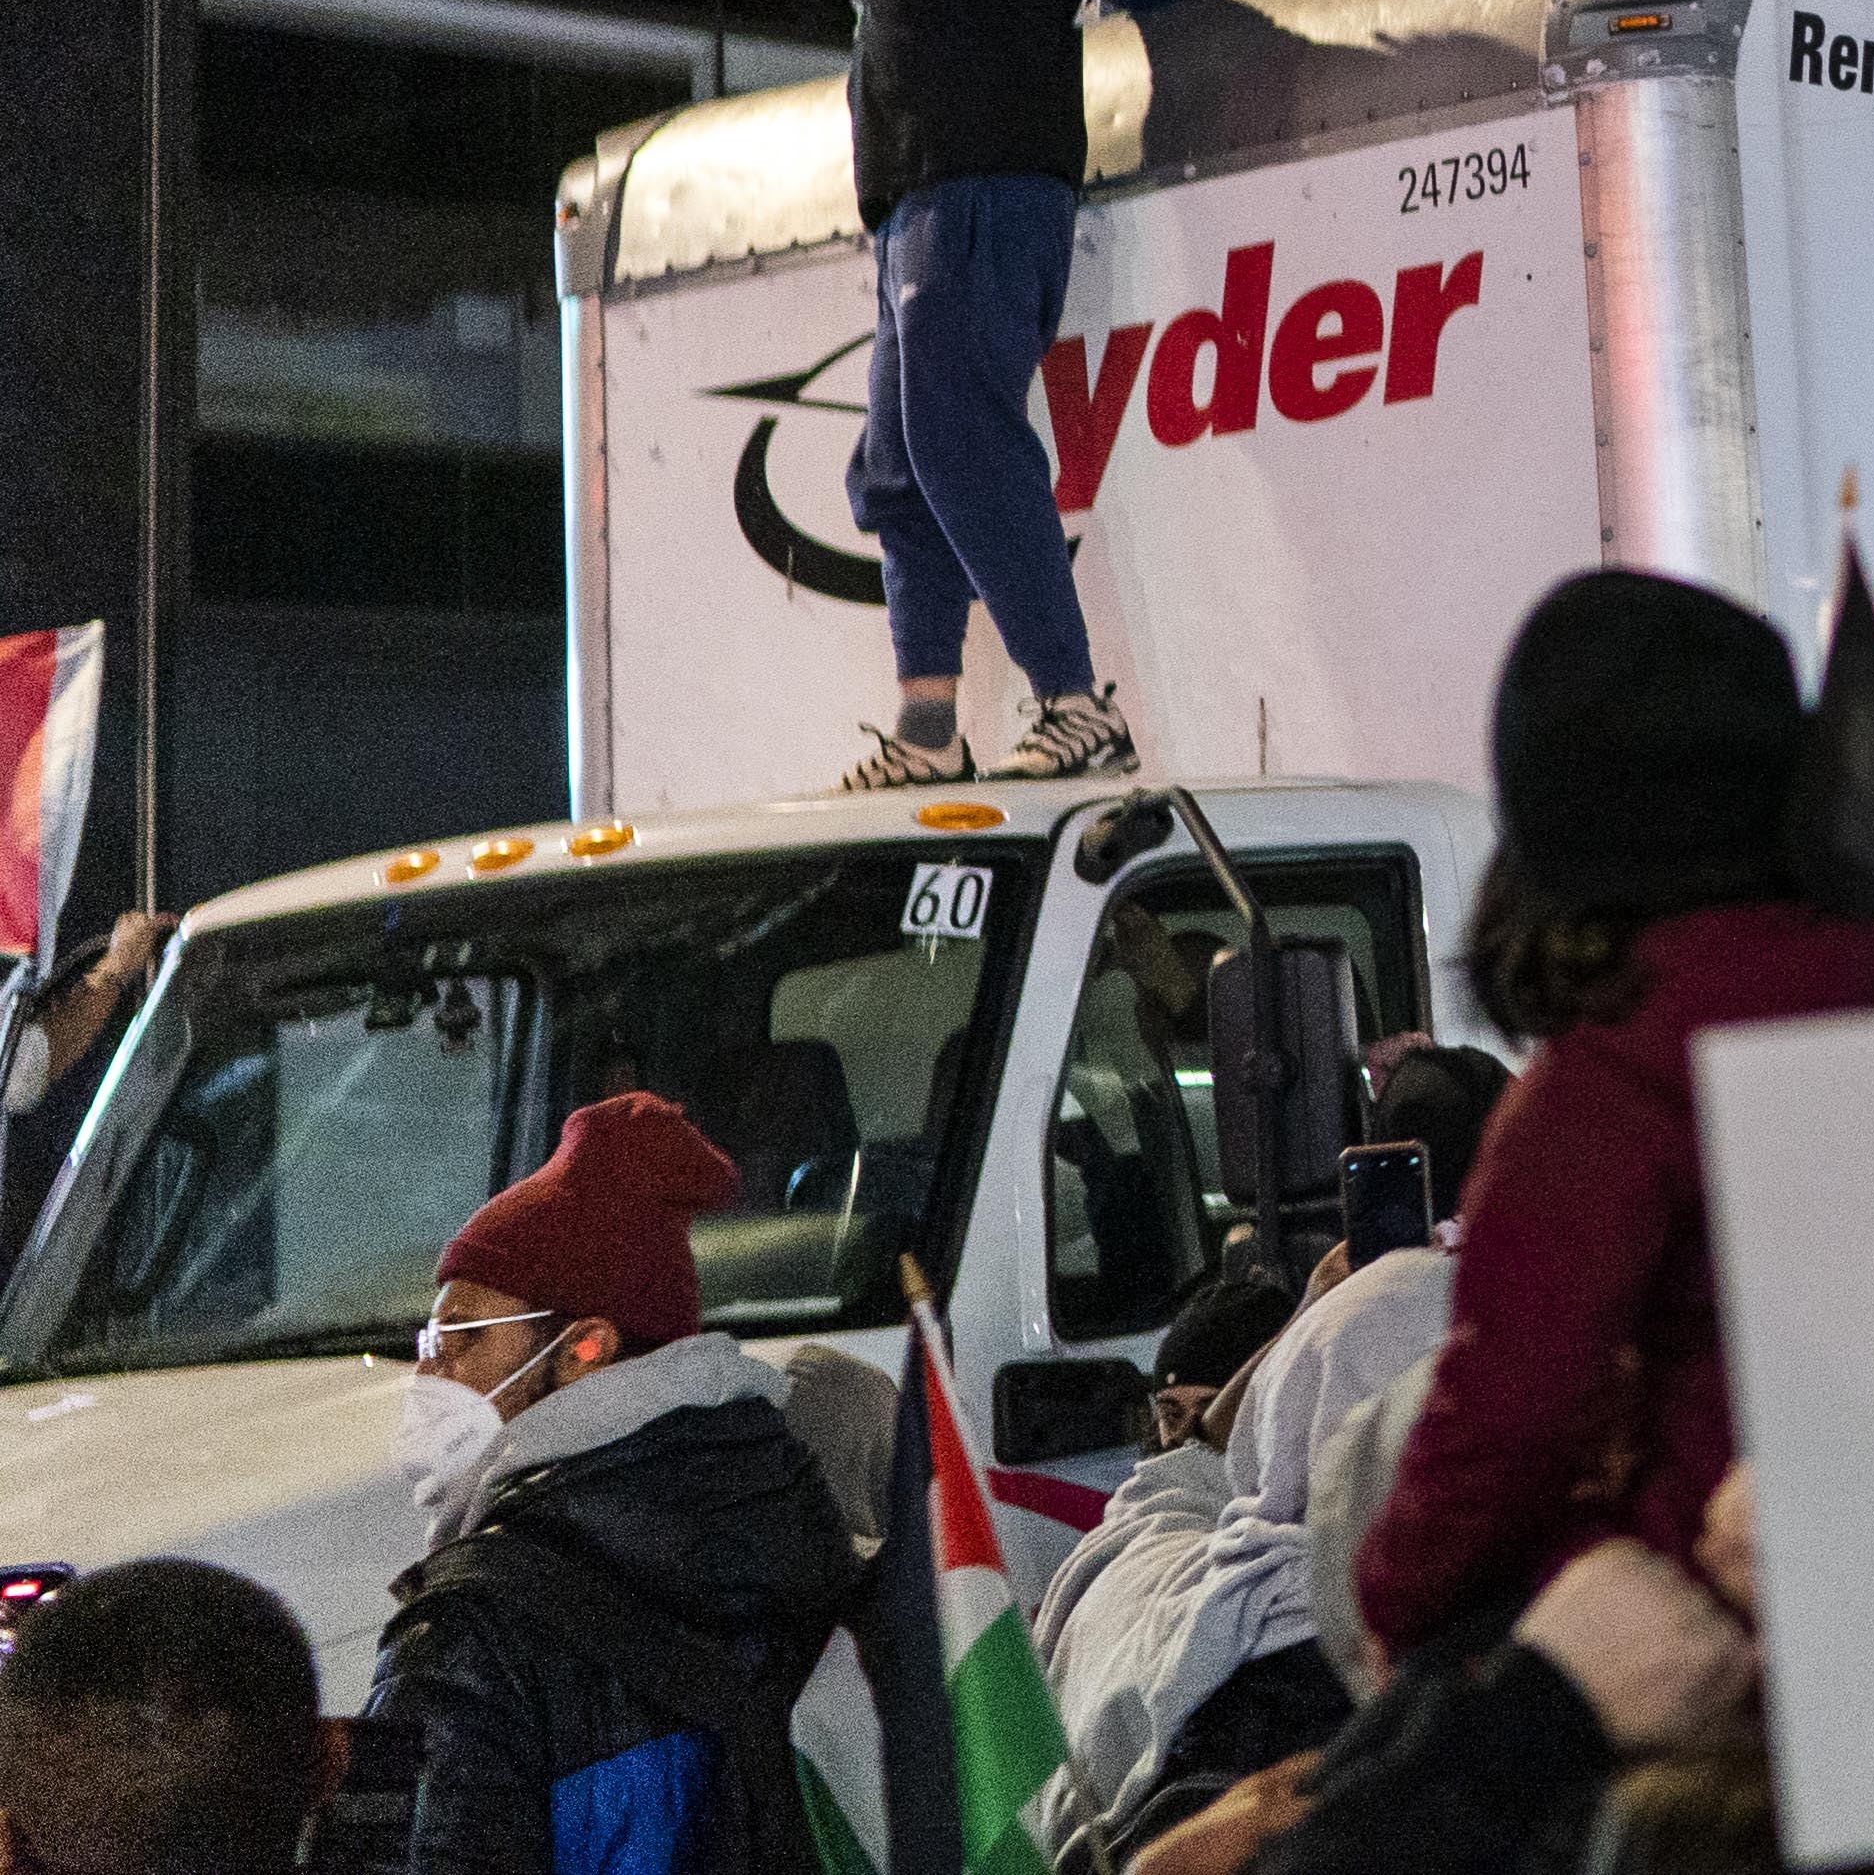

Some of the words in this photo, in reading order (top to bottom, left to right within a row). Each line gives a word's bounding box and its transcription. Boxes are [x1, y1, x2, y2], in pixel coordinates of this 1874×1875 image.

[1397, 142, 1532, 216] 247394
[1040, 241, 1483, 514] yder
[909, 868, 986, 931] 60
